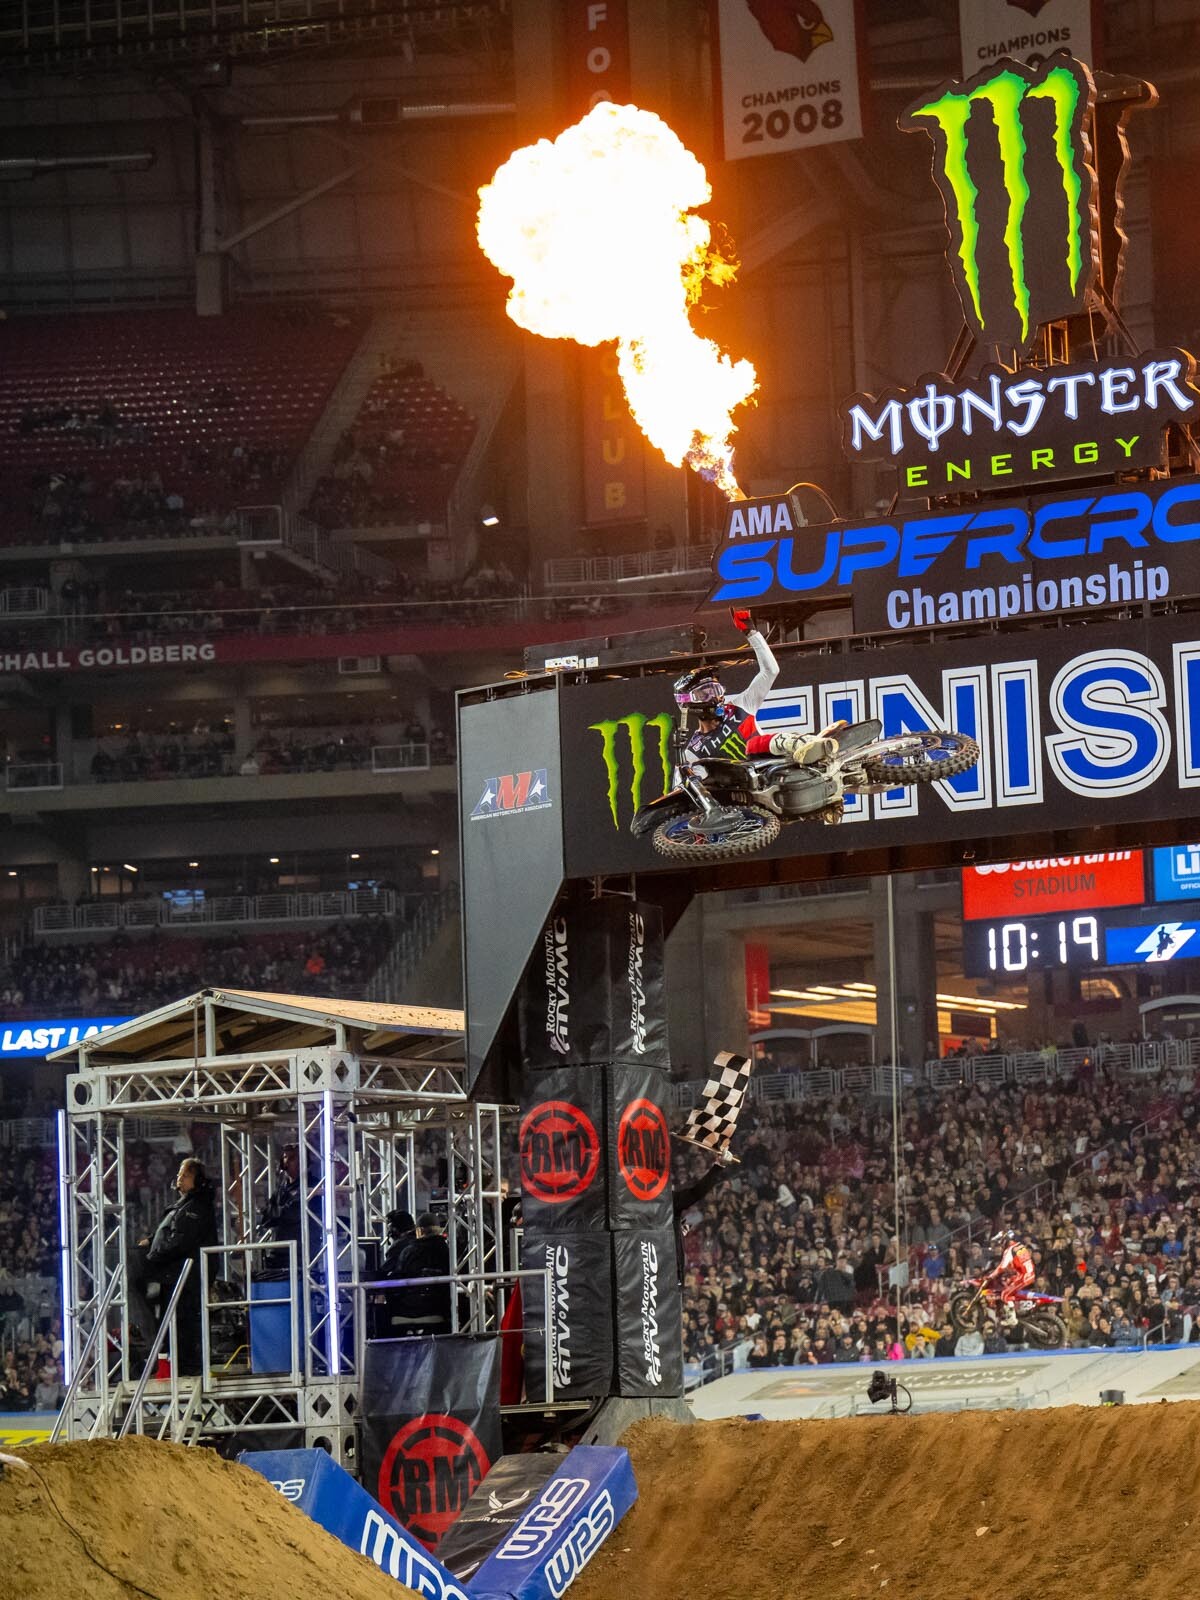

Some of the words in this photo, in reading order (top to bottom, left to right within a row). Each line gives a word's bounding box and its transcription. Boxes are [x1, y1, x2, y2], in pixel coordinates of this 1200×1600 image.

[977, 27, 1072, 60] CHAMPIONS
[741, 80, 841, 109] CHAMPIONS
[742, 98, 844, 144] 2008
[850, 357, 1195, 454] MONSTER
[906, 435, 1141, 487] ENERGY
[729, 502, 793, 538] AMA
[886, 559, 1170, 630] Championship
[0, 652, 70, 671] HALL
[79, 644, 216, 666] GOLDBERG
[470, 768, 552, 815] AMA
[1013, 873, 1097, 897] STADIUM
[545, 924, 556, 987] MOUNTA
[989, 916, 1099, 971] 10:19
[546, 990, 557, 1033] ROCKY
[2, 1027, 65, 1051] LAST
[68, 1025, 114, 1043] LA
[641, 1241, 650, 1317] MOUNTAIN
[642, 1318, 652, 1363] ROCKY
[270, 1479, 305, 1501] PS
[401, 1456, 468, 1514] RM
[496, 1479, 590, 1559] WPS
[361, 1510, 470, 1600] WP
[544, 1489, 615, 1599] WPS
